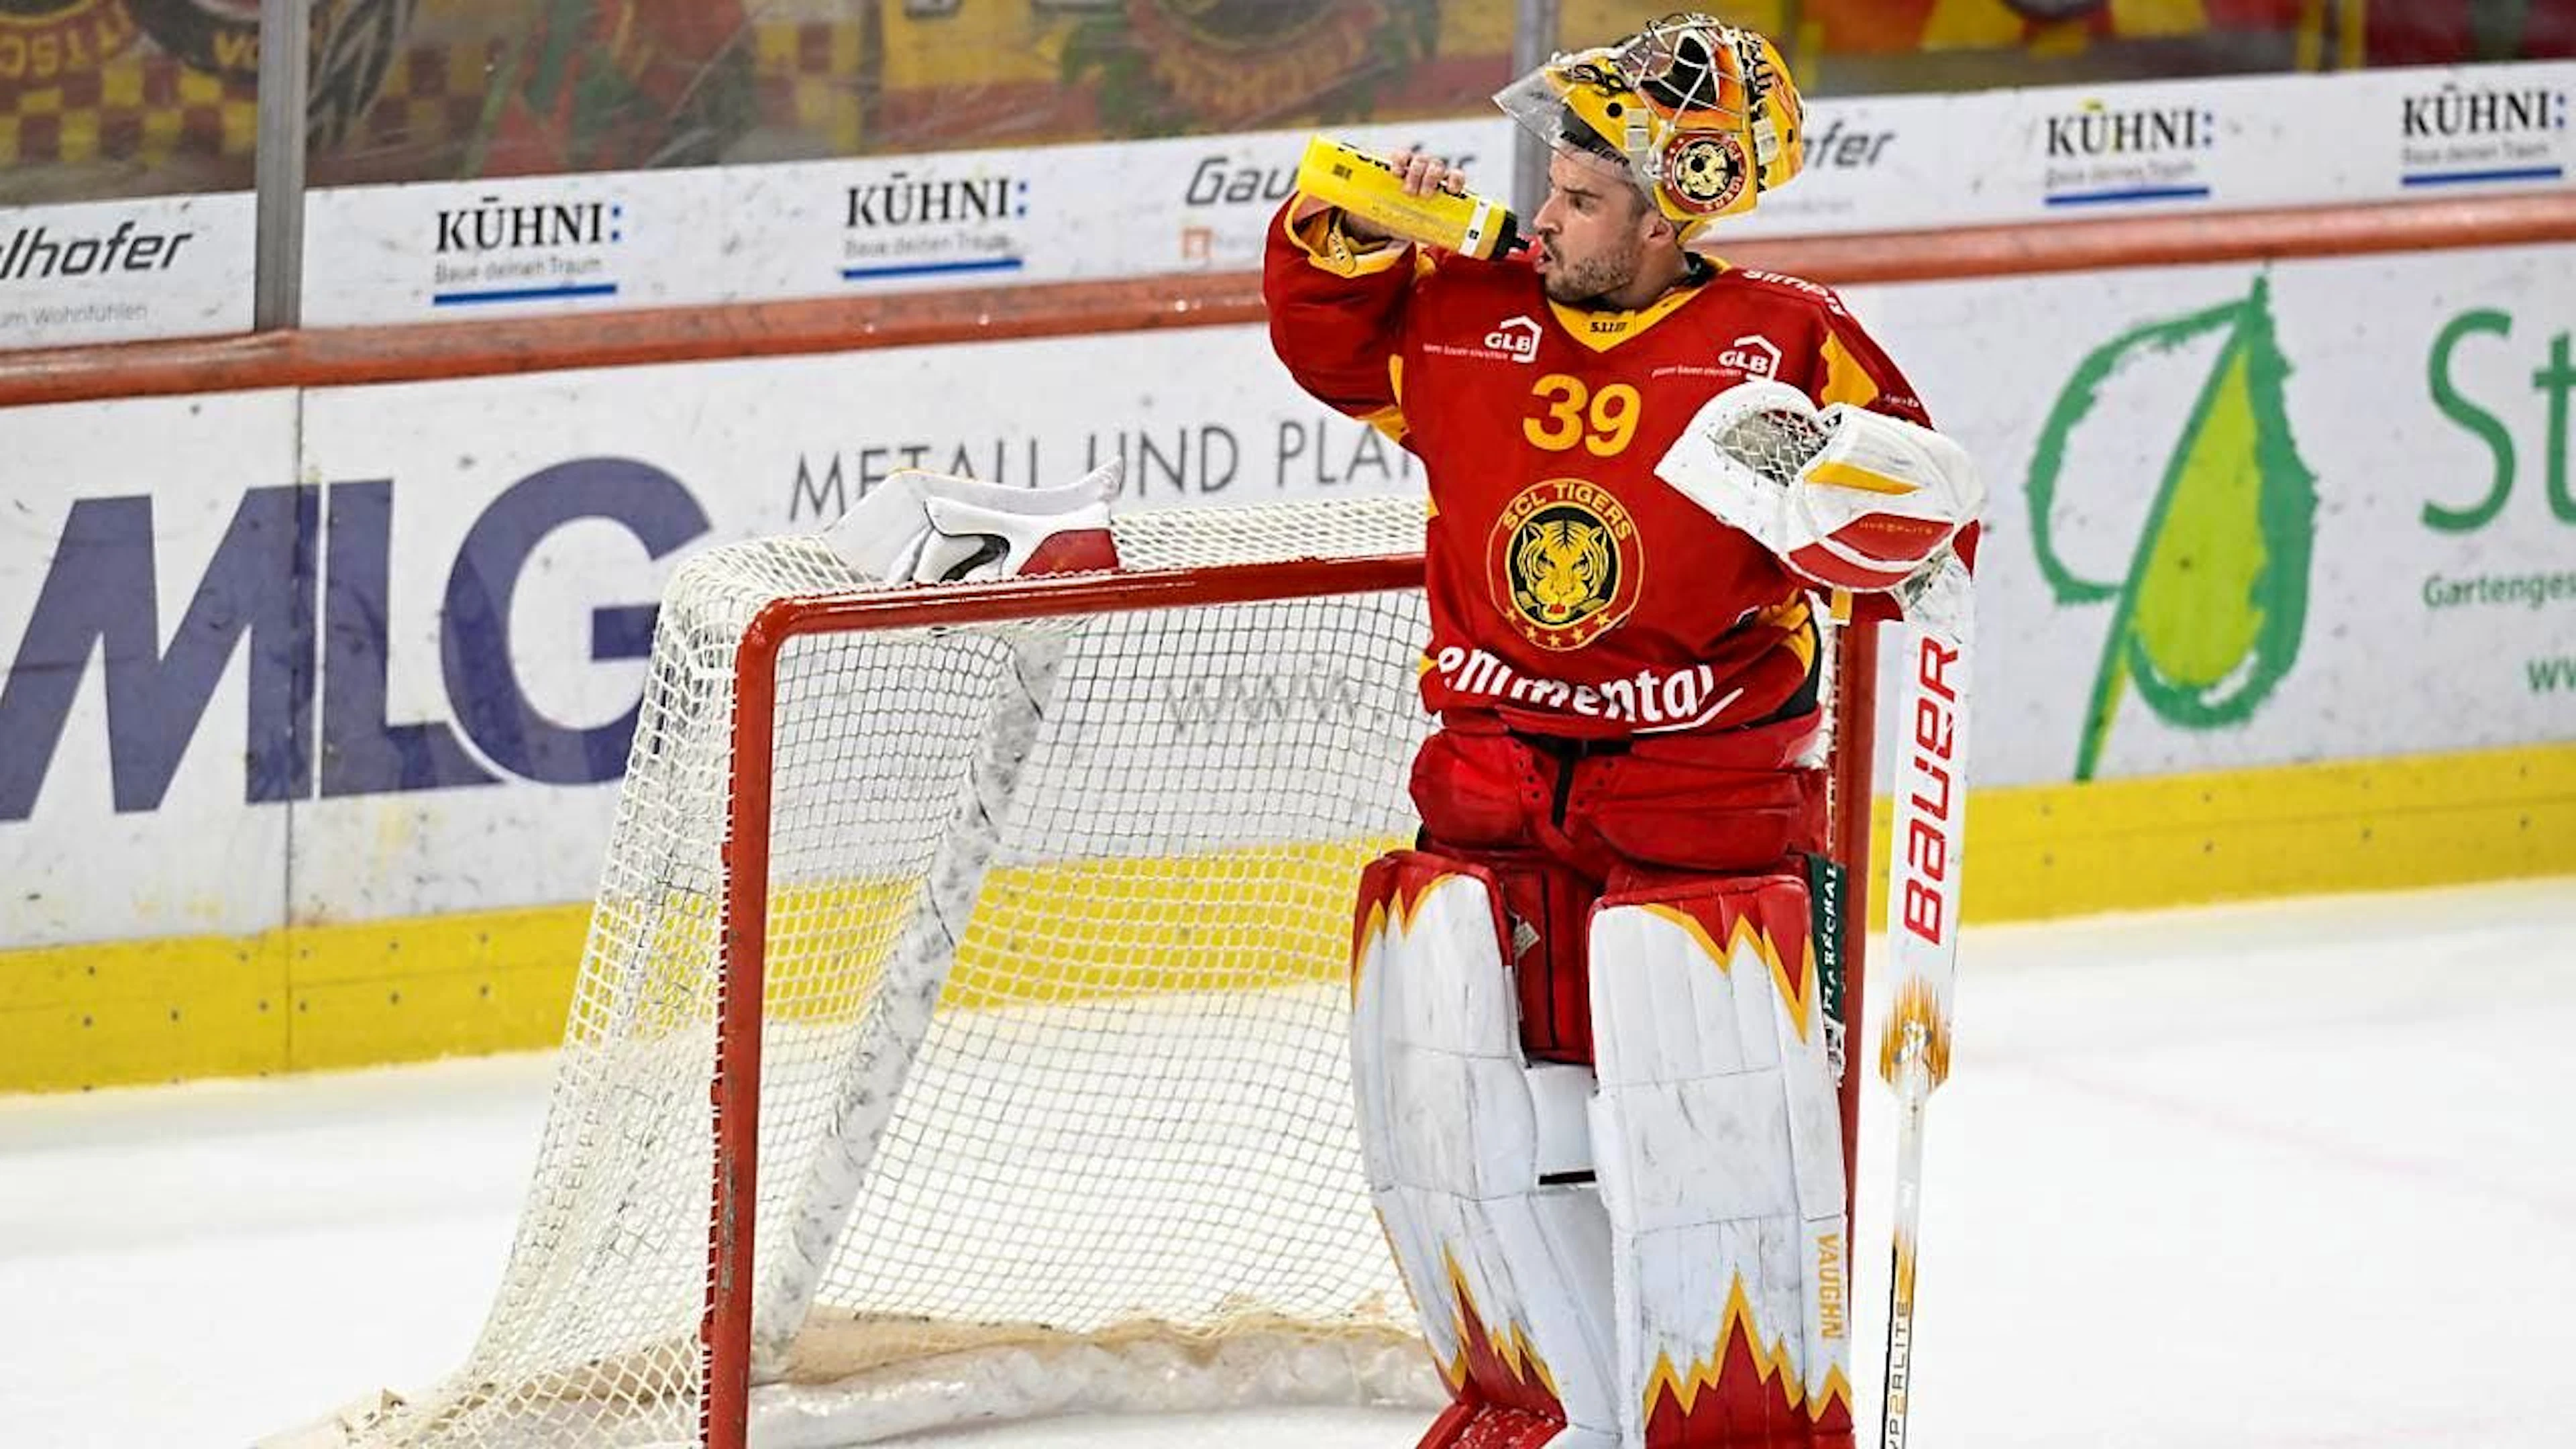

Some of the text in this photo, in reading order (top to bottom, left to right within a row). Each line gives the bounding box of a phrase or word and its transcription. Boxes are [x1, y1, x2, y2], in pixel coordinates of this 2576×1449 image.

[0, 220, 194, 280] lhofer
[1485, 333, 1532, 352] GLB
[1718, 351, 1769, 374] GLB
[1523, 374, 1642, 457] 39
[1087, 425, 1240, 497] UND
[1503, 483, 1631, 541] SCL TIGERS
[0, 456, 712, 824] MLG
[1816, 1233, 1845, 1340] VAUGHN
